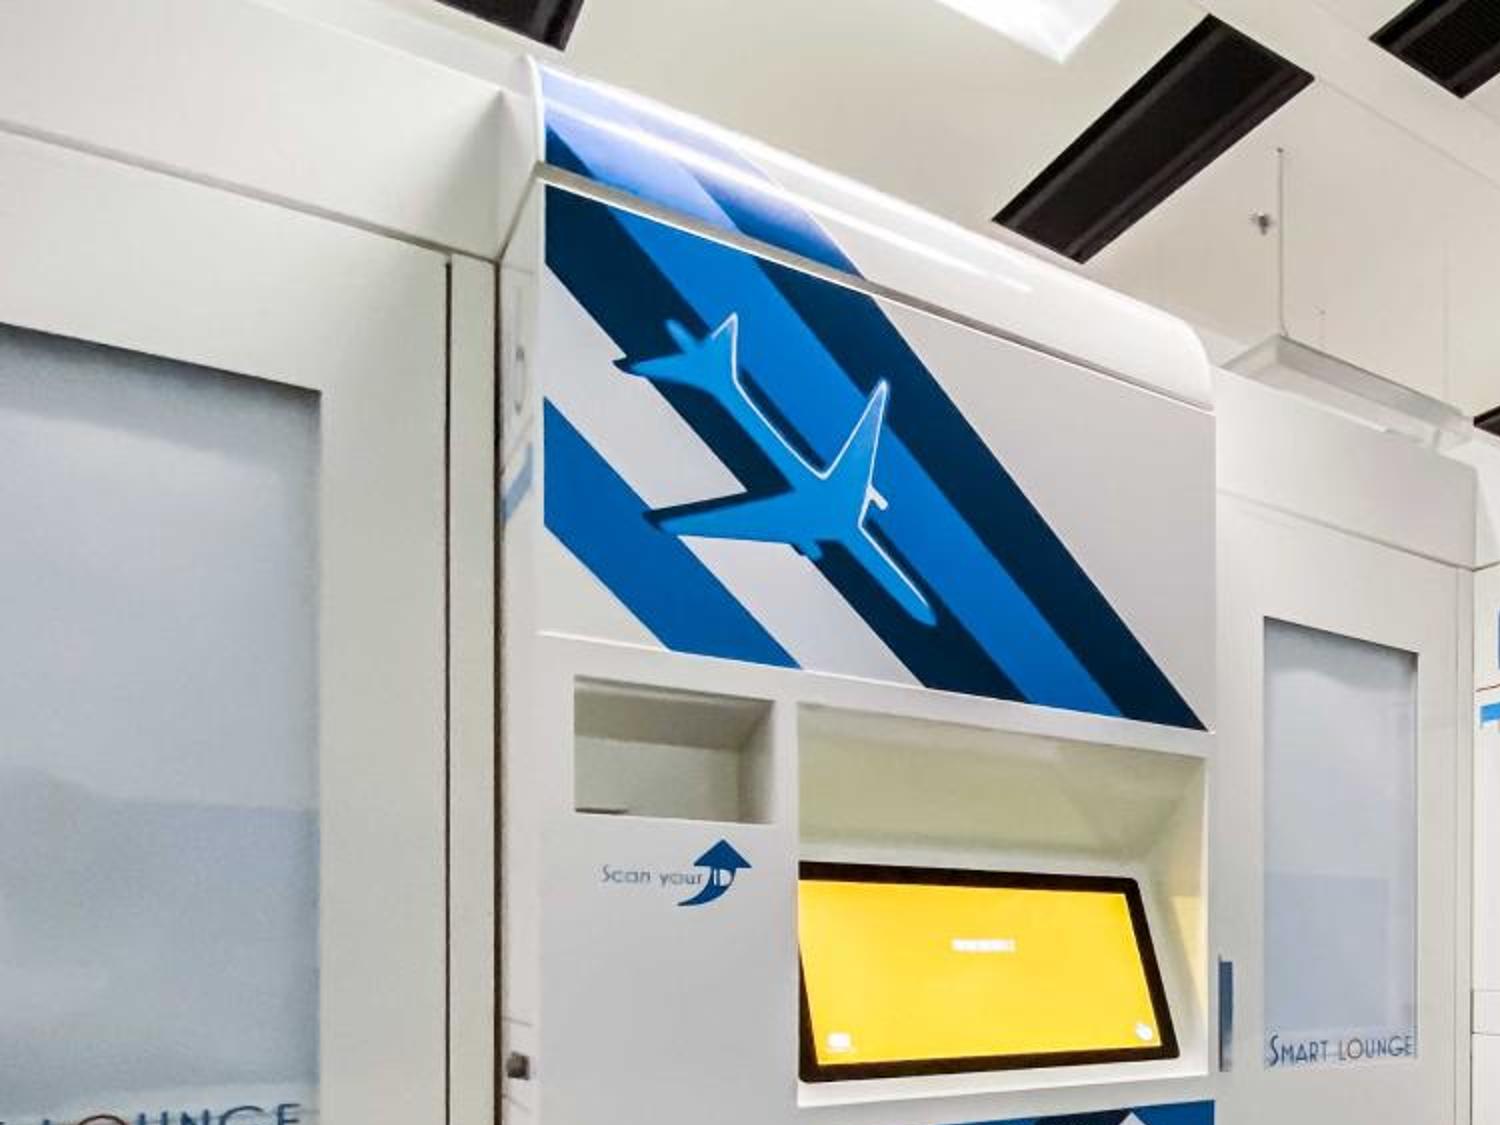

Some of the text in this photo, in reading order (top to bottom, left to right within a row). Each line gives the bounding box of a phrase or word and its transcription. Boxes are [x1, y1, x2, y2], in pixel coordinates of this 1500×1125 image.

[602, 864, 735, 887] Scan your ID
[1338, 1035, 1413, 1061] LOUNGE
